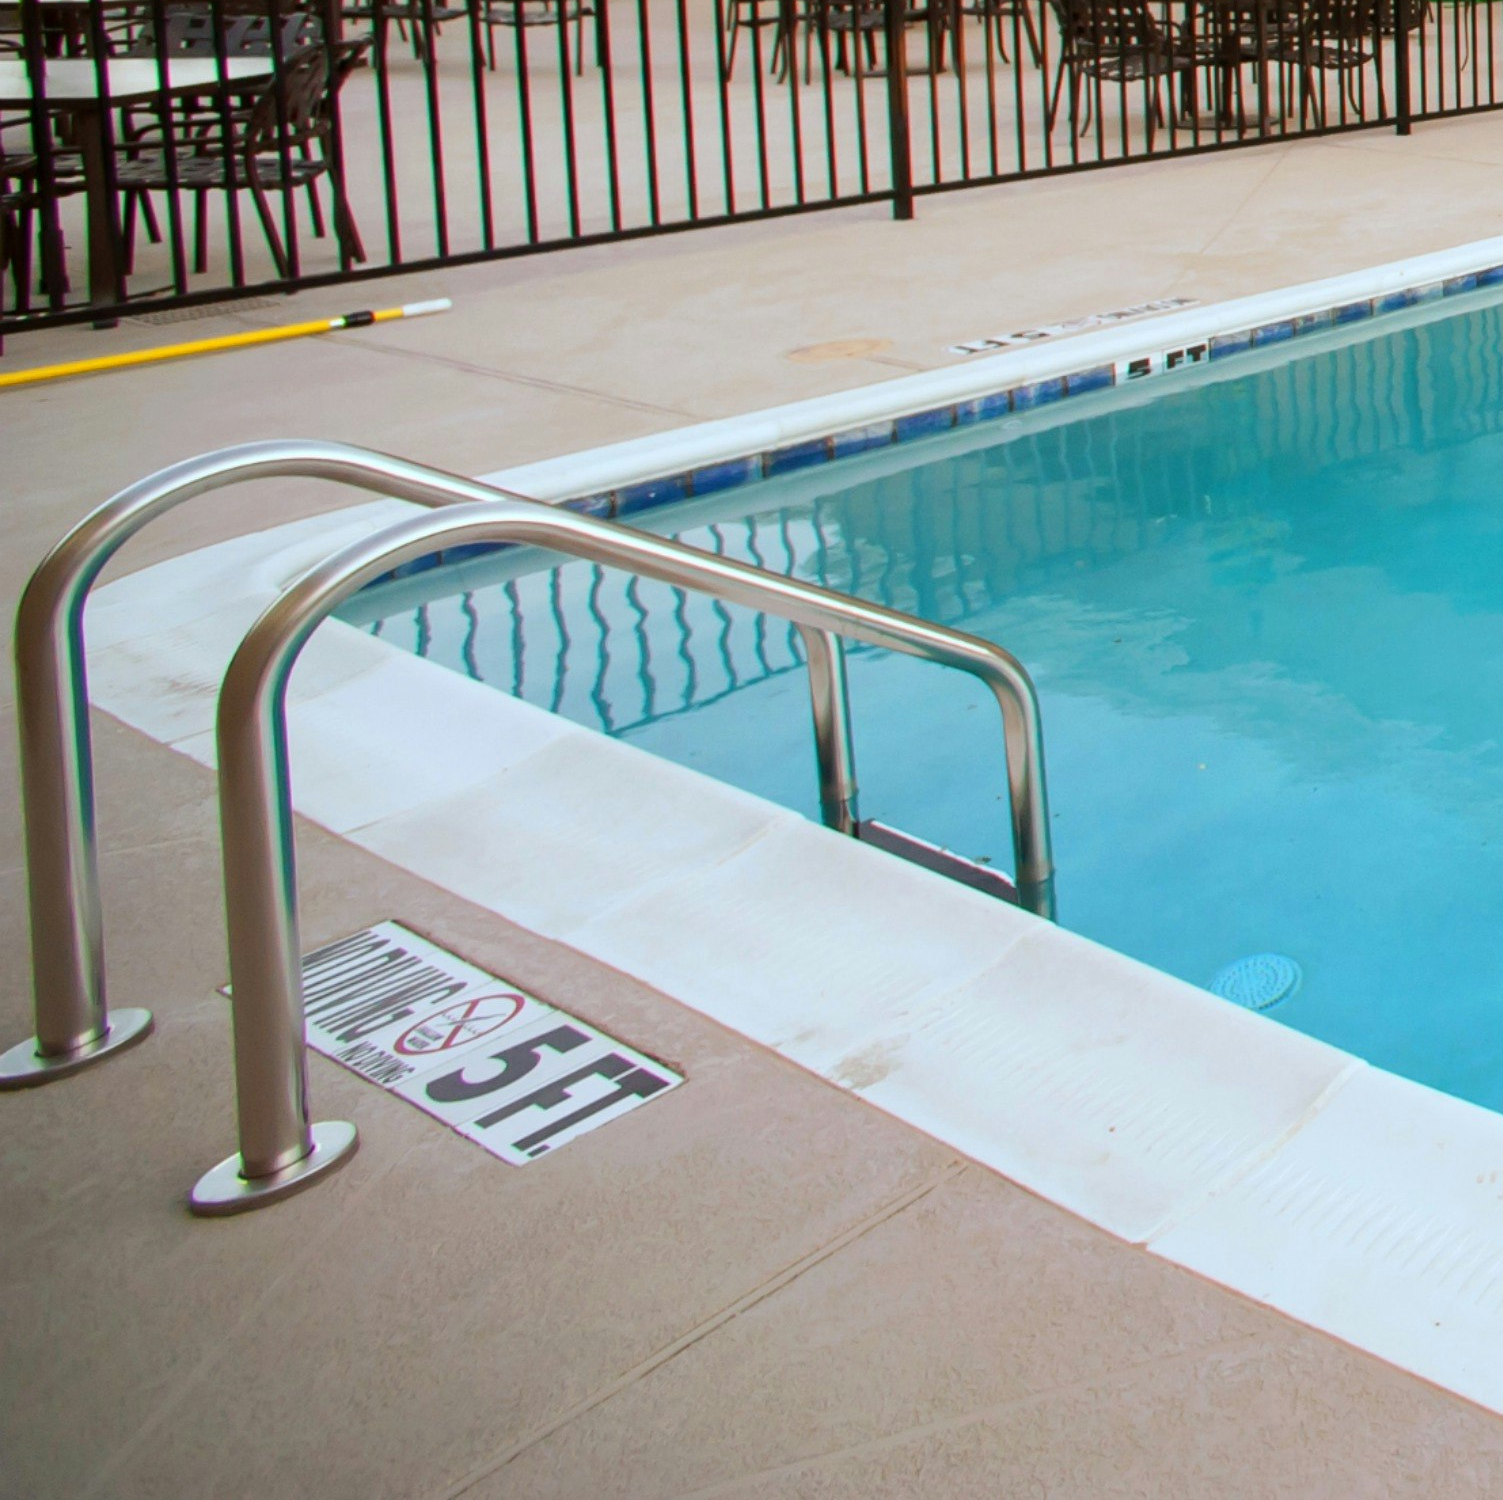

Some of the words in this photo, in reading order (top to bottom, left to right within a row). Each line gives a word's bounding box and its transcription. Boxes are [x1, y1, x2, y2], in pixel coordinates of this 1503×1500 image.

[1166, 344, 1207, 369] FT
[302, 947, 468, 1044] DIVING
[425, 1024, 593, 1103] 5
[474, 1052, 671, 1157] FT.
